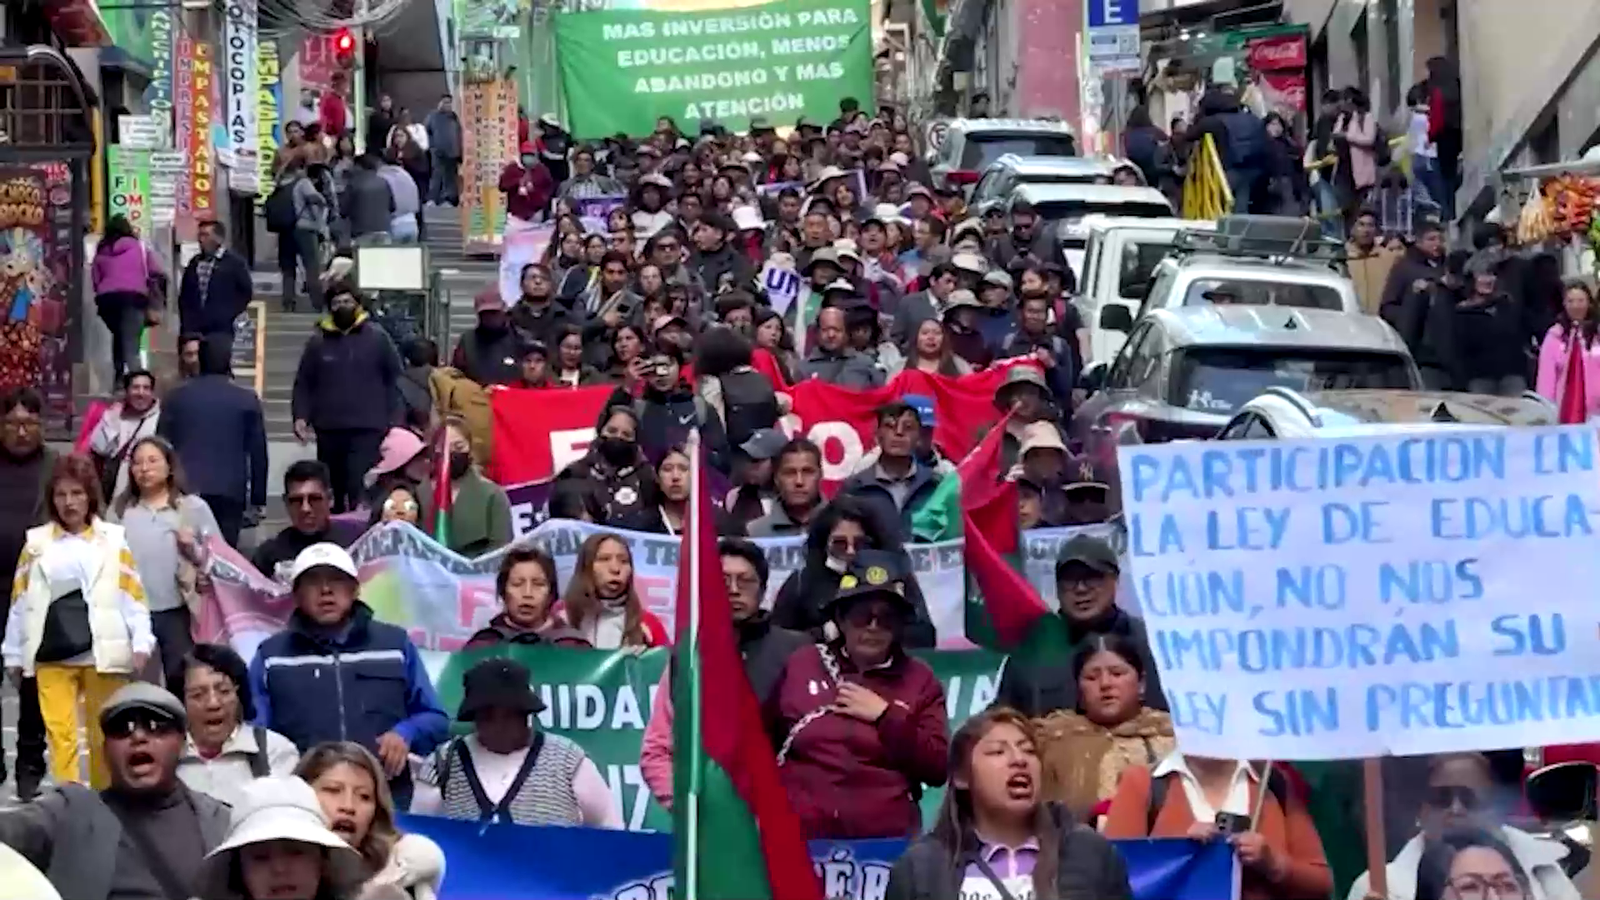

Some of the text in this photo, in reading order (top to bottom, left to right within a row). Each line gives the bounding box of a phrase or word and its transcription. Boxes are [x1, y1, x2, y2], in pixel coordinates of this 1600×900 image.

[603, 21, 655, 40] MAS
[798, 8, 858, 27] PARA
[1104, 0, 1123, 23] E
[617, 35, 851, 68] EDUCACIÓN, MENOS
[634, 62, 845, 94] ABANDONO Y MAS
[193, 43, 211, 208] EMPASTADOS
[684, 93, 805, 120] ATENCIÓN
[1130, 436, 1505, 502] PARTICIPACION
[1132, 512, 1184, 558] LA
[1207, 507, 1291, 551] LEY
[1322, 501, 1393, 545] DE
[1275, 564, 1347, 610] NO
[1379, 557, 1485, 605] NOS
[1490, 612, 1567, 657] SU
[1167, 688, 1227, 737] LEY
[1253, 685, 1339, 737] SIN
